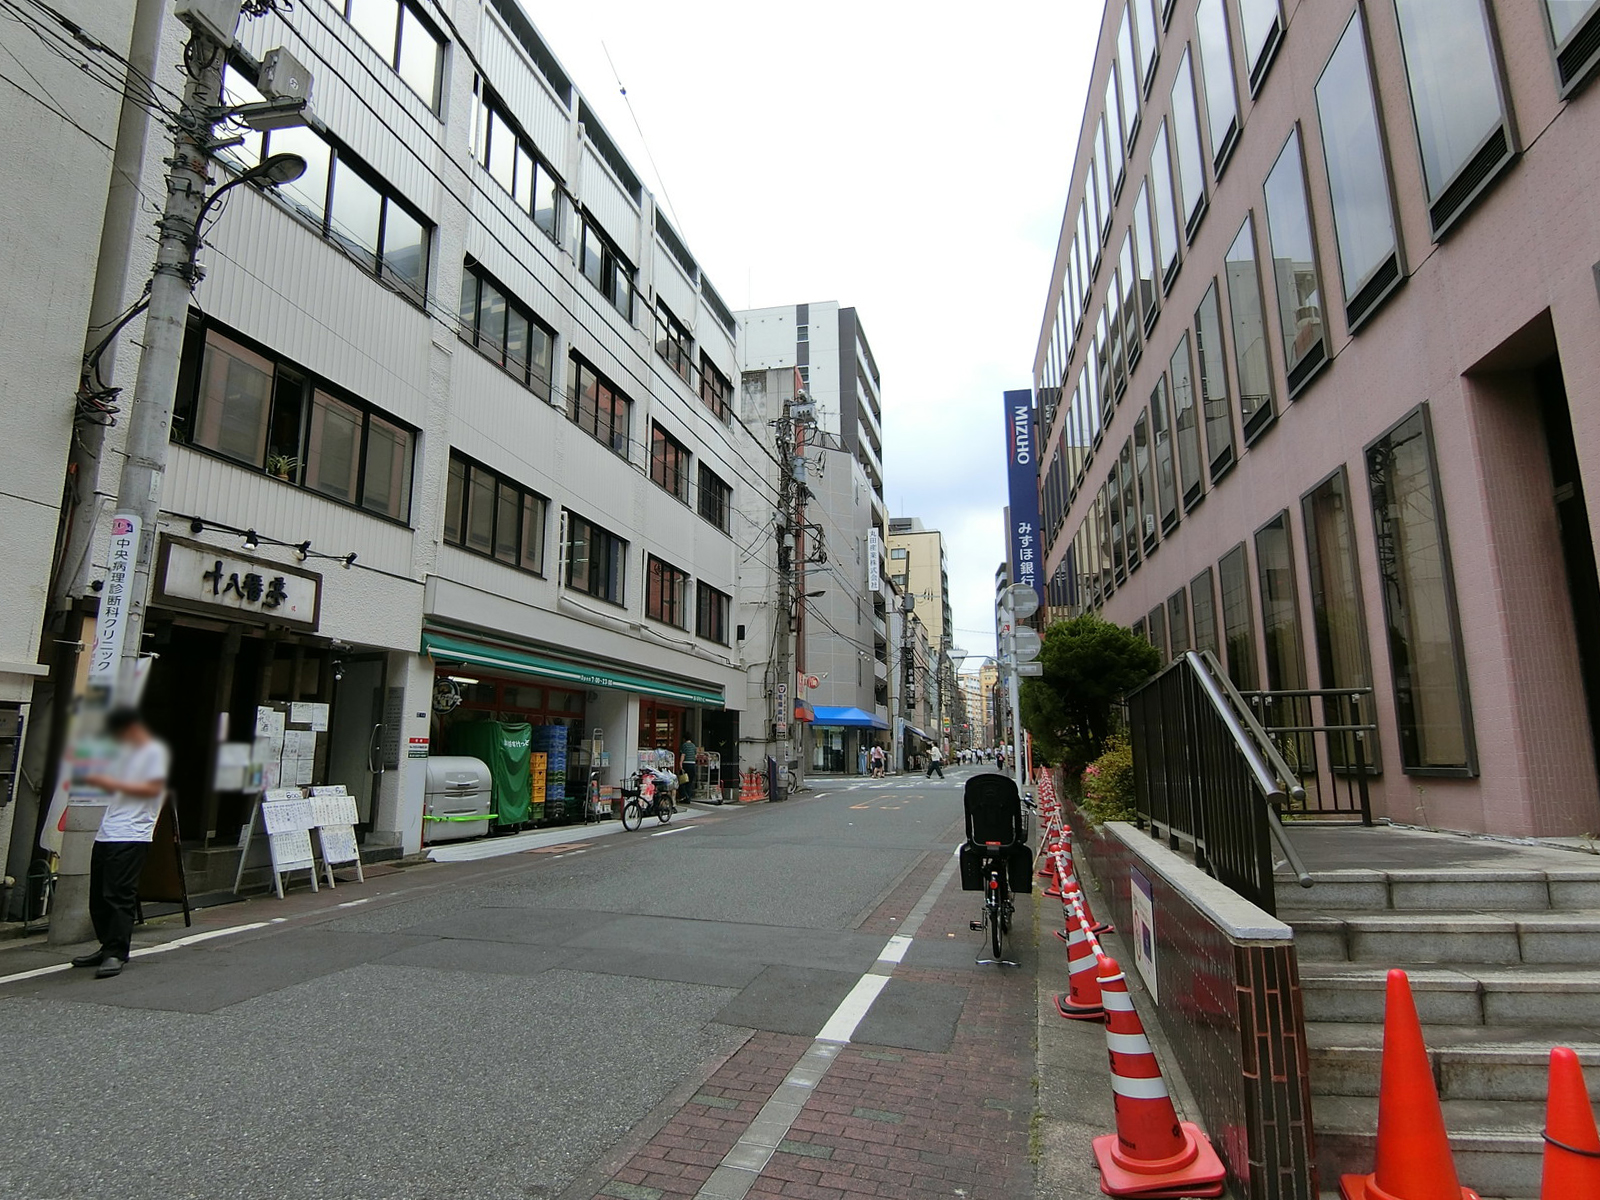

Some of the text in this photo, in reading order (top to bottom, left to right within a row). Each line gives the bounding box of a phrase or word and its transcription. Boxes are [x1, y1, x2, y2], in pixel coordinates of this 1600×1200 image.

[1014, 405, 1030, 465] MIZUHO
[1017, 521, 1036, 588] みずほ銀行
[97, 537, 131, 672] 中央病理診断科クリニック
